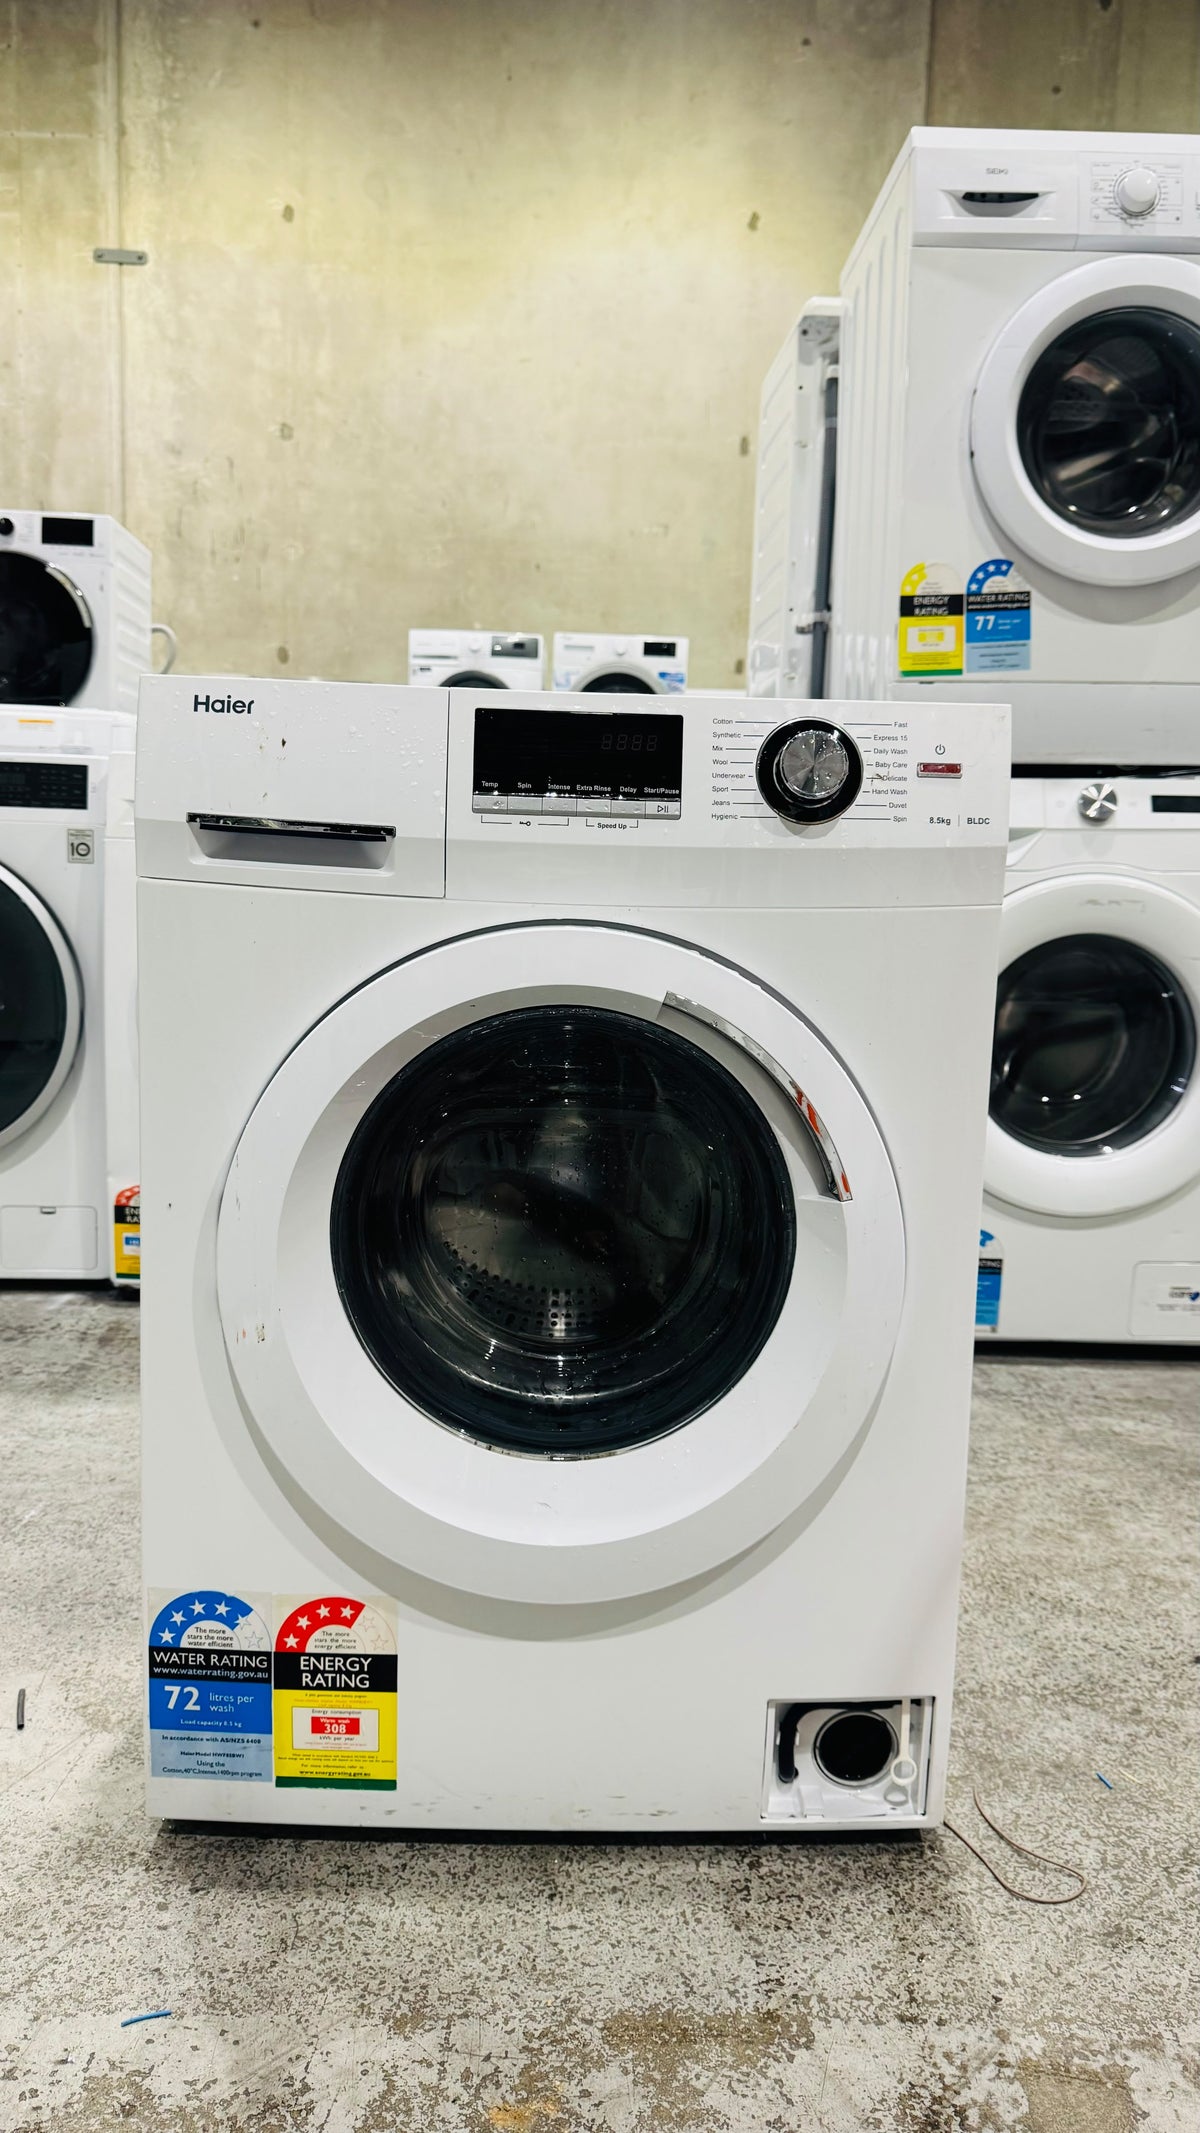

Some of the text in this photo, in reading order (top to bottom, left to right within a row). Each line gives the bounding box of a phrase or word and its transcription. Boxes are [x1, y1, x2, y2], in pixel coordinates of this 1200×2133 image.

[914, 597, 950, 605] ENERGY
[968, 593, 1029, 603] WATER RATING
[914, 607, 948, 615] RATING
[974, 615, 996, 631] 77
[194, 695, 254, 714] Haier
[873, 748, 889, 756] Daily
[620, 786, 637, 794] Delay
[643, 787, 680, 795] Start/Pause
[711, 813, 738, 821] Hygienic
[929, 817, 990, 825] 8.5kg BLDC
[597, 822, 615, 830] Speed
[70, 842, 91, 857] 10
[153, 1651, 268, 1669] WATER RATING
[300, 1656, 372, 1672] ENERGY
[153, 1667, 269, 1680] www.waterrating.gov.au
[302, 1672, 370, 1689] RATING
[164, 1685, 201, 1711] 72
[209, 1692, 254, 1705] litres per
[209, 1704, 235, 1713] wash
[324, 1723, 347, 1734] 308
[196, 1760, 214, 1768] Using
